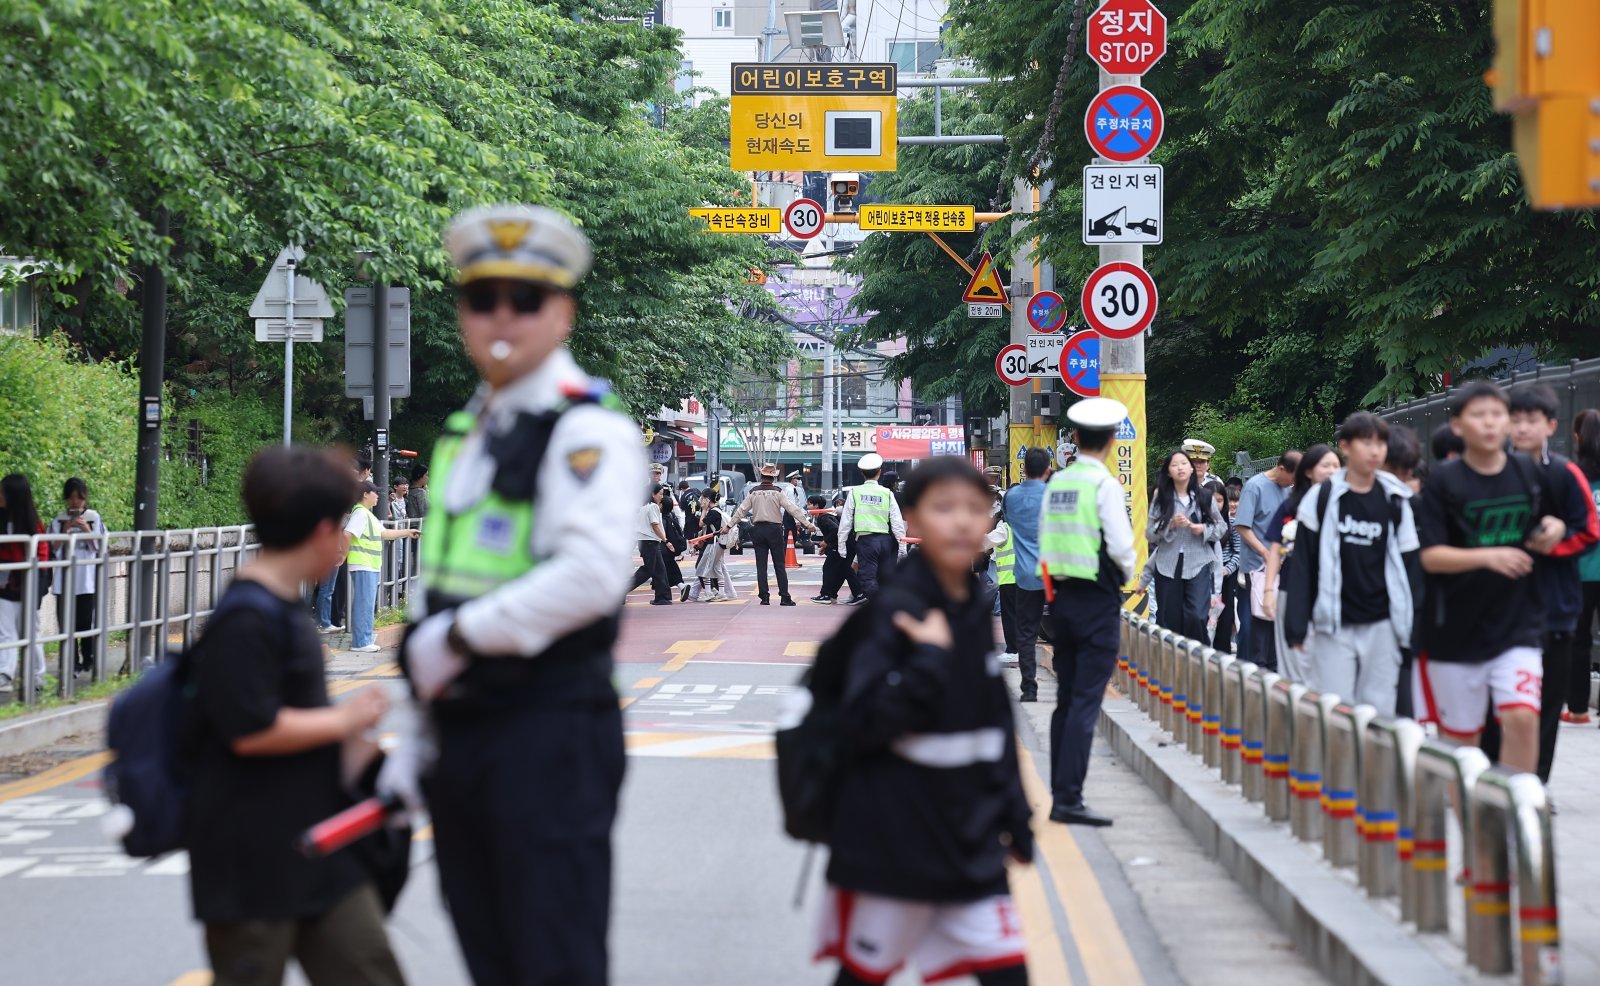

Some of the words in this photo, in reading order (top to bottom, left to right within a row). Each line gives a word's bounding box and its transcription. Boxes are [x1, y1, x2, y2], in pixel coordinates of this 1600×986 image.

[1098, 9, 1152, 36] 정지
[1099, 42, 1154, 63] STOP
[741, 69, 886, 89] 어린이보호구역
[755, 112, 802, 129] 당신의
[1097, 118, 1152, 130] 주정차금지
[746, 137, 811, 155] 현재속도
[1090, 174, 1156, 189] 견인지역
[793, 209, 818, 228] 30
[868, 210, 922, 226] 어린이보호구역
[925, 211, 940, 227] 적용
[943, 211, 966, 227] 단속중
[1101, 283, 1140, 318] 30
[970, 306, 982, 316] 전방
[985, 307, 1000, 316] 20m
[1029, 338, 1064, 349] 견인지역
[1006, 356, 1026, 375] 30
[1069, 358, 1099, 370] 주정차
[1338, 514, 1382, 540] Jeep
